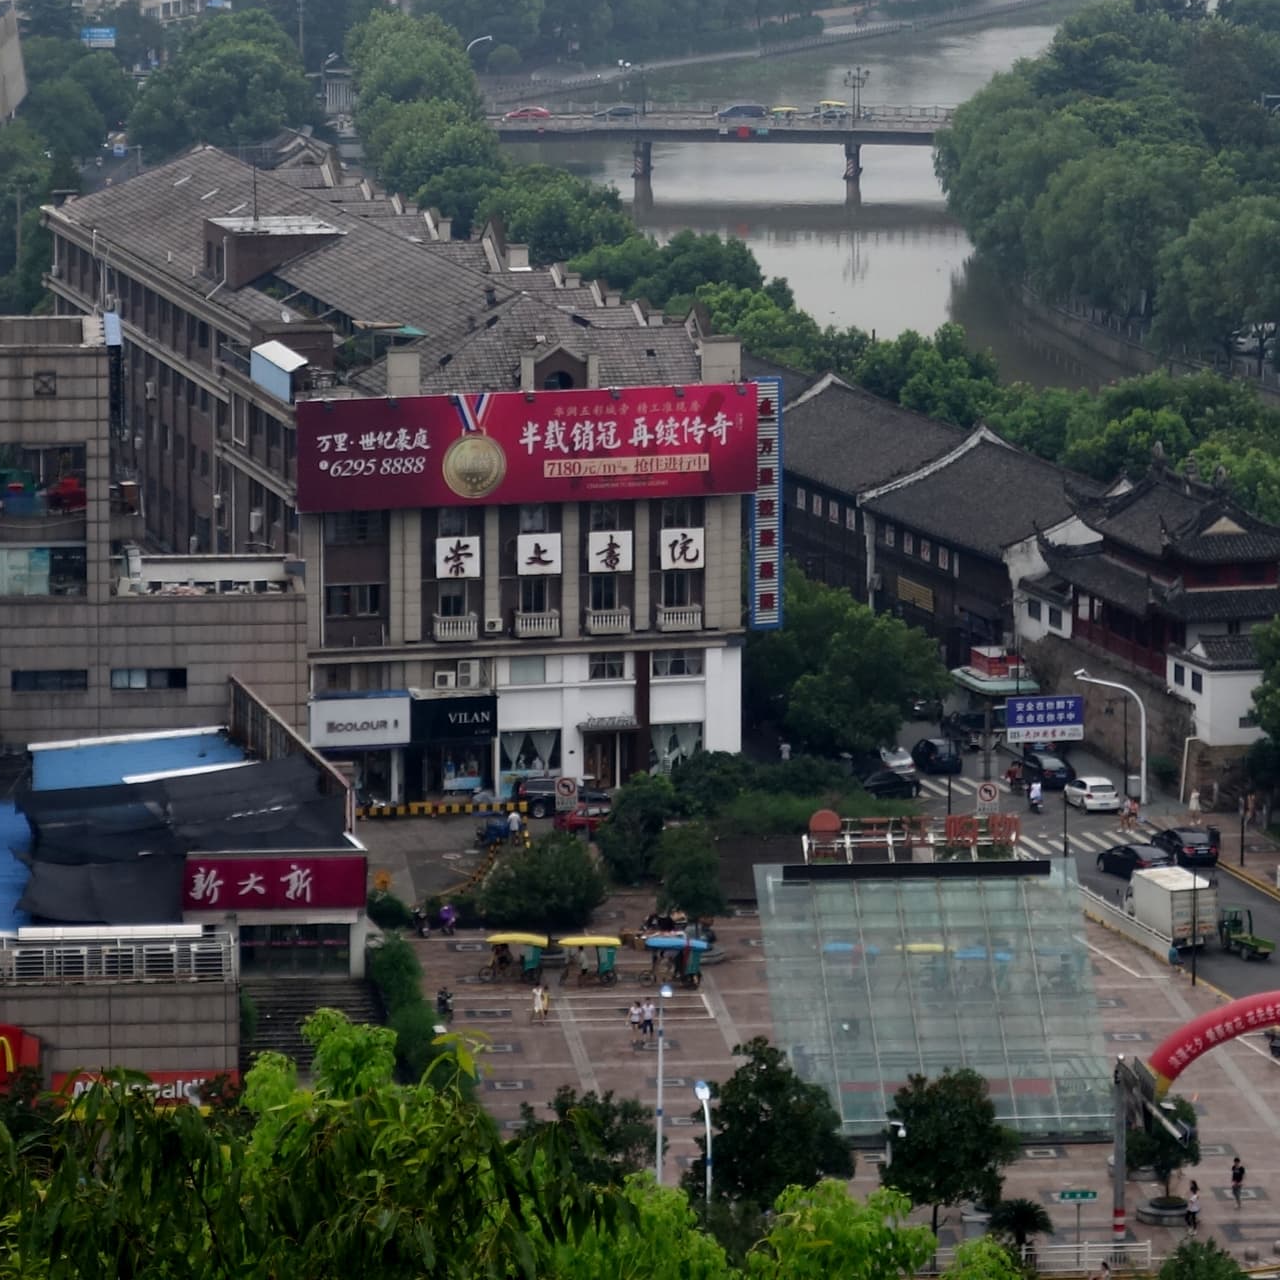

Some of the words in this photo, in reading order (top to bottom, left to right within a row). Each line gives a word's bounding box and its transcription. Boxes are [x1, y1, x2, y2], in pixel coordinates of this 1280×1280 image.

[518, 420, 622, 456] 半载销冠
[627, 412, 734, 449] 再续传奇
[329, 458, 376, 478] 6295
[379, 455, 426, 475] 8888
[447, 711, 492, 724] VILAN
